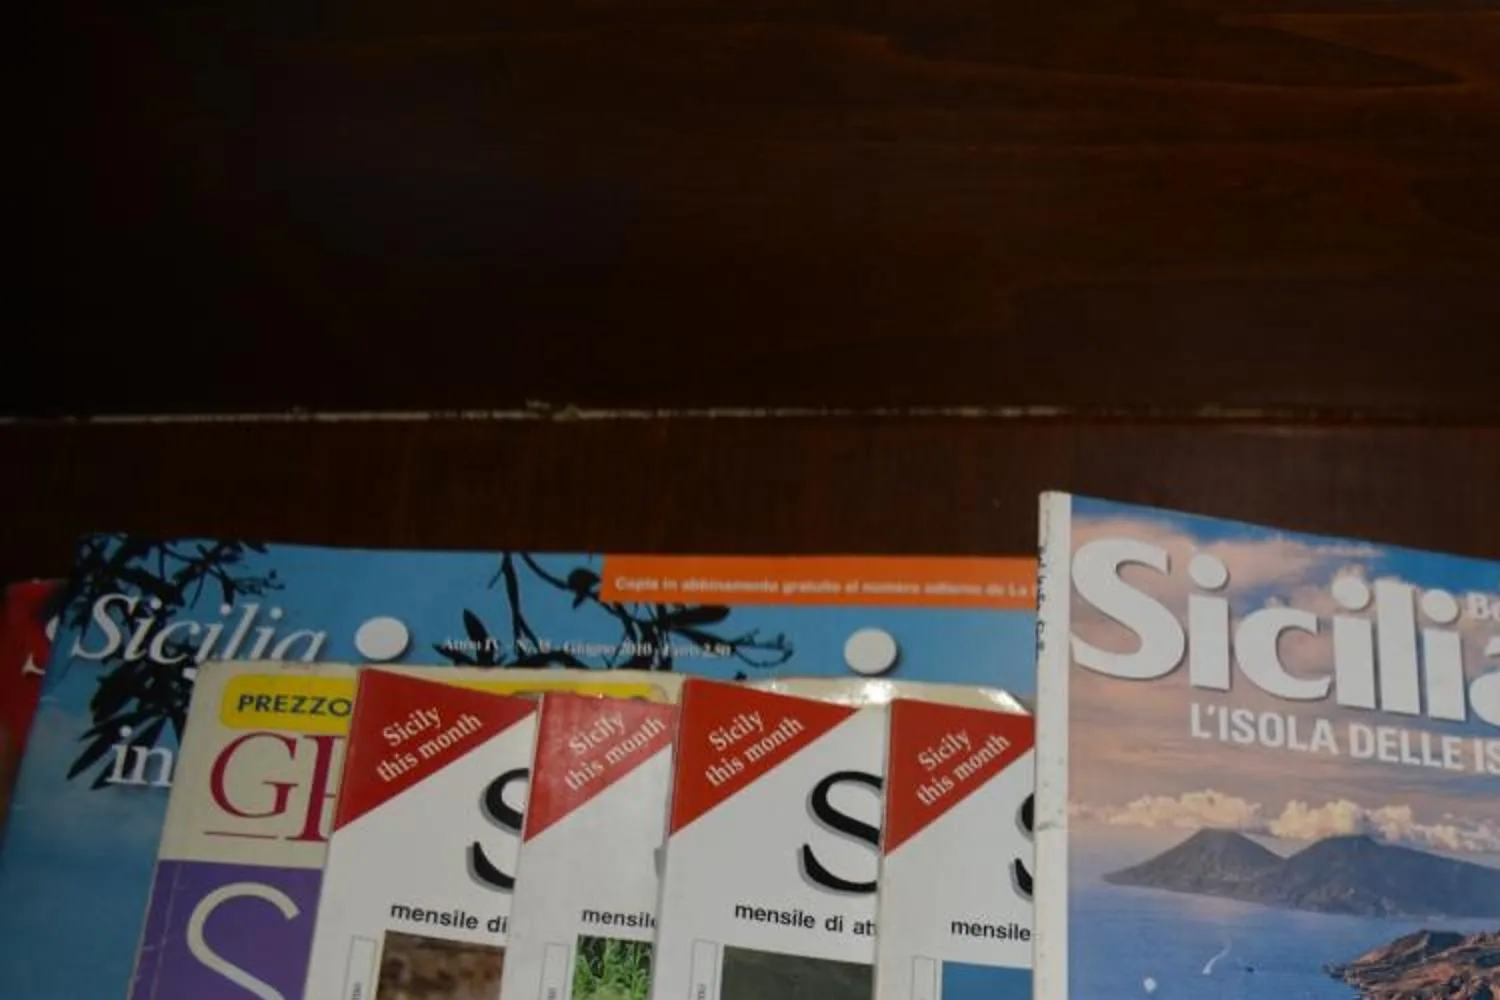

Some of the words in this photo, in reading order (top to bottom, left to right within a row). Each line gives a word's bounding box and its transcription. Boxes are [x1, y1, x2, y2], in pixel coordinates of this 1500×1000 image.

[68, 592, 327, 664] Sicilia
[238, 693, 352, 717] PREZZO
[382, 705, 443, 748] Sicily
[375, 753, 419, 783] this
[419, 712, 483, 765] month
[569, 709, 627, 756] Sicily
[704, 756, 745, 788] this
[744, 715, 805, 764] month
[708, 709, 765, 752] Sicily
[917, 728, 972, 772] Sicily
[1190, 703, 1340, 755] L'ISOLA
[1348, 721, 1464, 771] DELLE
[564, 760, 604, 792] this
[604, 716, 667, 766] month
[915, 774, 955, 806] this
[953, 733, 1012, 782] month
[390, 903, 479, 930] mensile
[487, 915, 509, 935] di
[734, 902, 816, 929] mensile
[825, 915, 844, 933] di
[950, 918, 1032, 941] mensile
